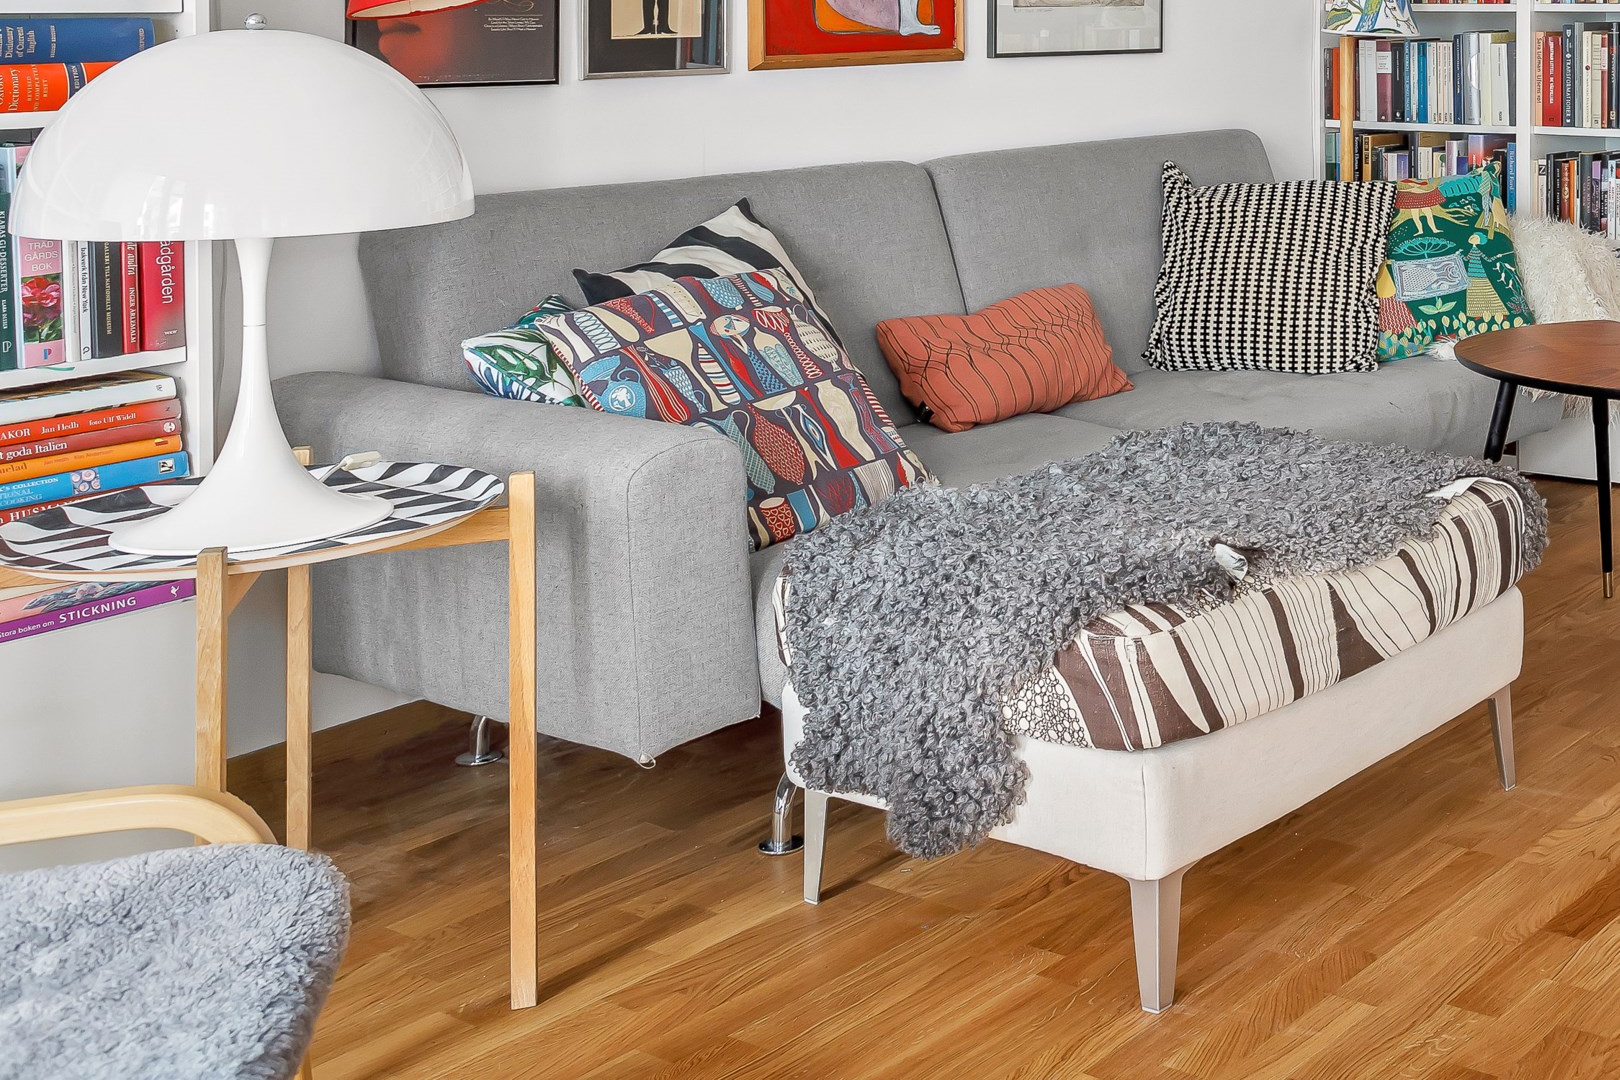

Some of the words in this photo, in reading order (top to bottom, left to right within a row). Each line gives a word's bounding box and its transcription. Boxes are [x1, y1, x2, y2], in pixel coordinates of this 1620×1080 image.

[26, 29, 36, 54] English
[8, 68, 21, 112] Dictionary
[24, 253, 59, 262] GÅRDS
[79, 247, 88, 271] bakverk
[80, 271, 89, 285] från
[81, 285, 90, 299] New
[81, 299, 90, 313] York
[41, 424, 56, 436] Jan
[57, 420, 80, 433] Hedh
[89, 418, 103, 426] foto
[103, 415, 115, 425] Ulf
[116, 412, 137, 424] Widell
[6, 446, 33, 462] goda
[34, 440, 68, 455] Italien
[17, 623, 41, 635] boken
[42, 620, 55, 630] om
[59, 596, 137, 623] STICKNING
